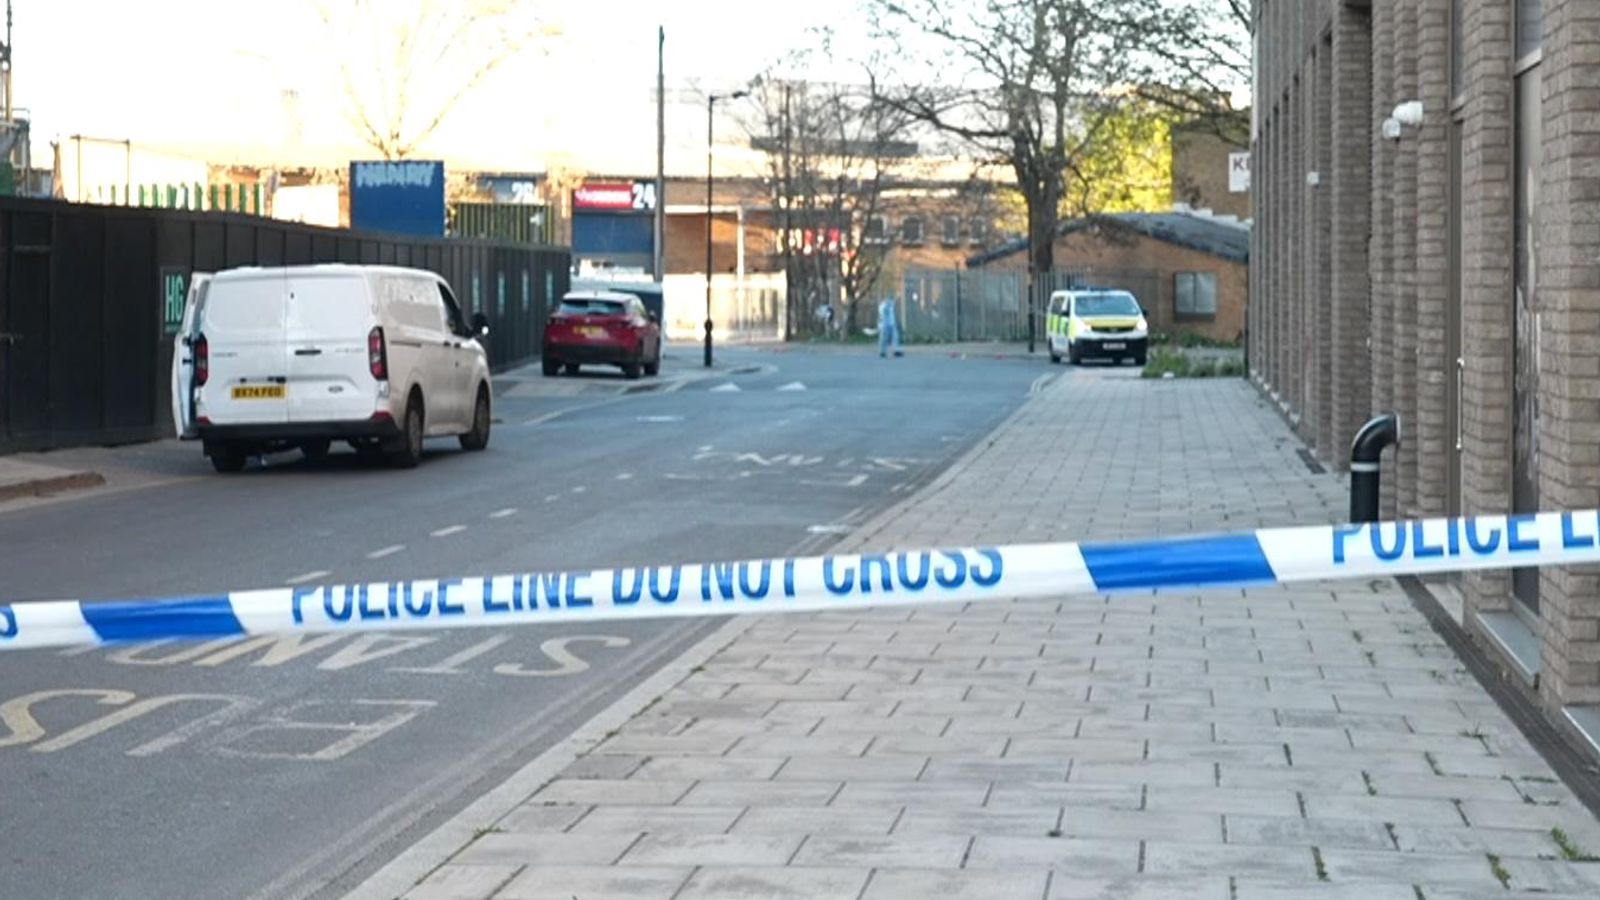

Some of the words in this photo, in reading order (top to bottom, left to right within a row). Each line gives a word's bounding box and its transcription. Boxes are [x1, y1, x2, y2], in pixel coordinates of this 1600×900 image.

[632, 182, 656, 209] 24
[165, 274, 184, 323] HG
[1332, 514, 1540, 564] POLICE
[1561, 510, 1600, 549] L
[292, 580, 465, 624] POLICE
[483, 572, 593, 612] LINE
[612, 565, 682, 605] DO
[822, 546, 1002, 595] CROSS
